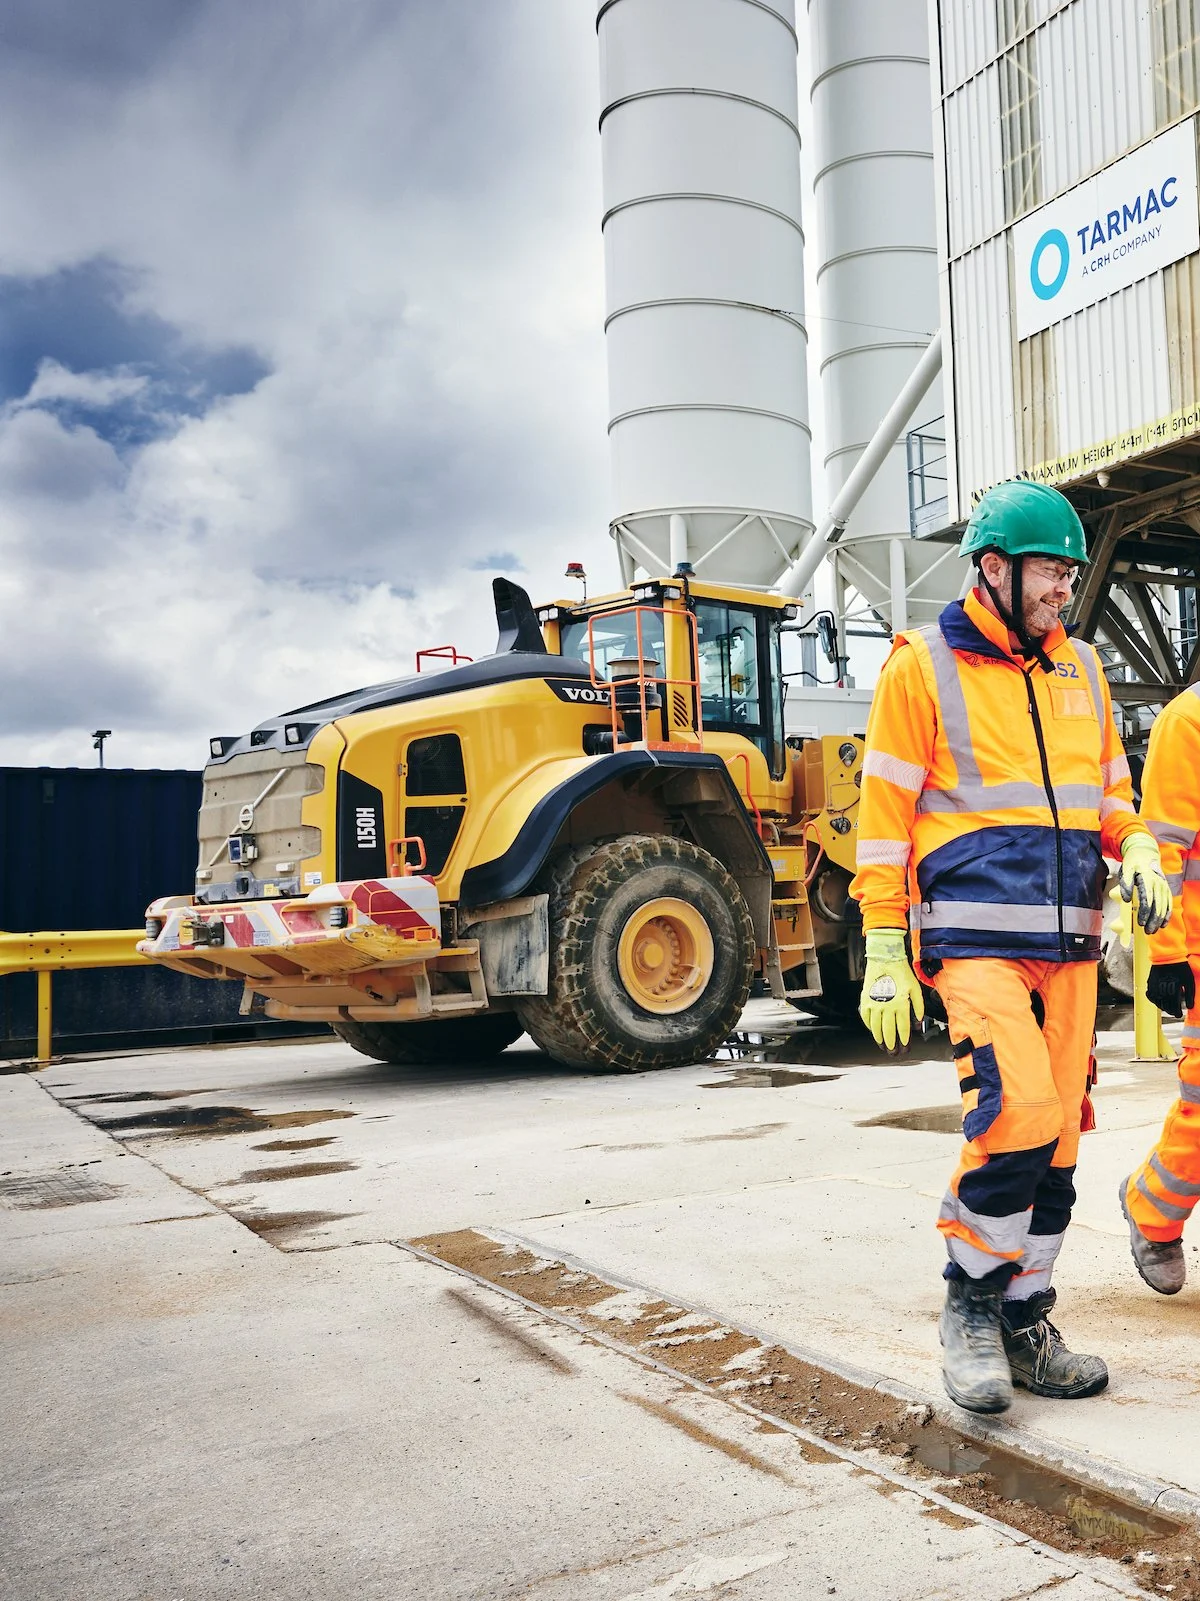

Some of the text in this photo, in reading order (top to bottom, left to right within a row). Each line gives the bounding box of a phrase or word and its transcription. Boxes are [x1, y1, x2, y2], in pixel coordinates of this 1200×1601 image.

[1077, 176, 1178, 255] TARMAC
[1081, 224, 1163, 278] A CRH COMPANY
[356, 808, 376, 848] L150H
